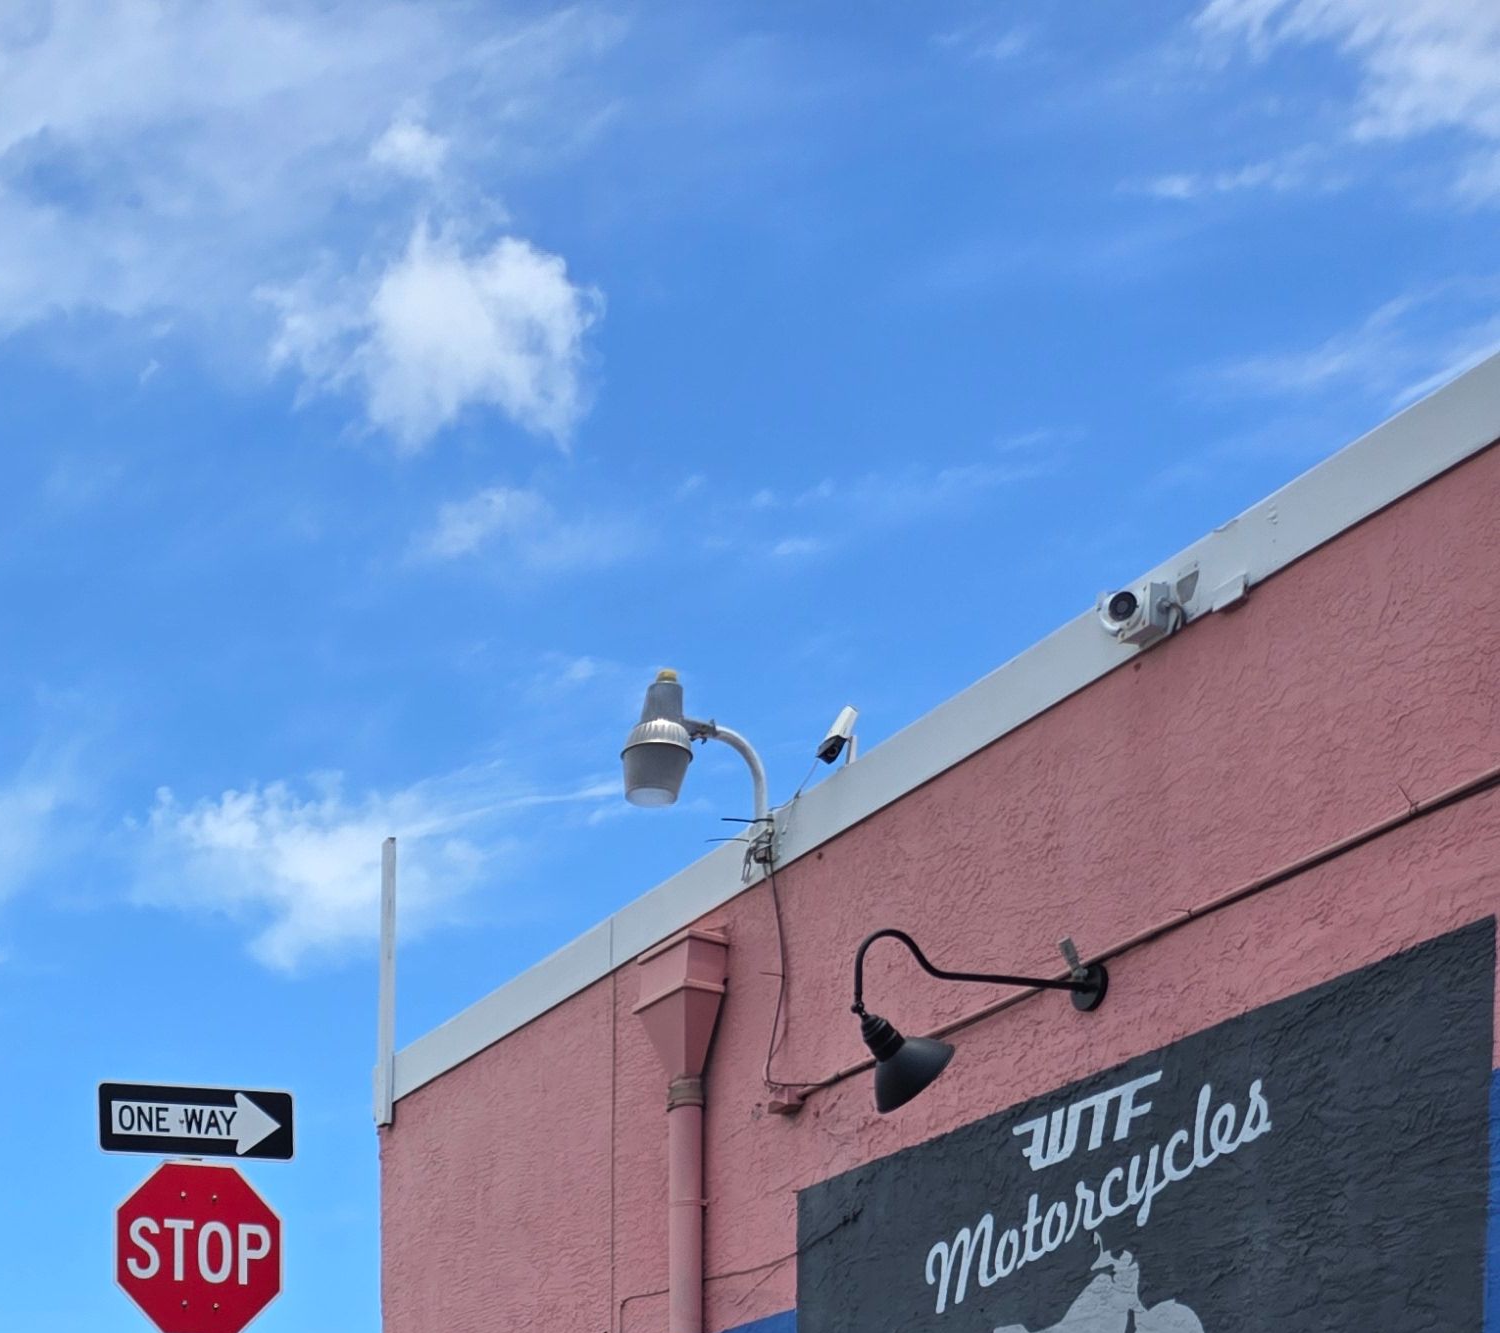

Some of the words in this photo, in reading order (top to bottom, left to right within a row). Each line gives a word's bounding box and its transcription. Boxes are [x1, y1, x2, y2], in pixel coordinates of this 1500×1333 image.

[118, 1105, 170, 1133] ONE
[184, 1108, 237, 1136] WAY
[1012, 1070, 1162, 1171] WTF
[925, 1079, 1271, 1314] Motorcycles
[126, 1216, 271, 1285] STOP
